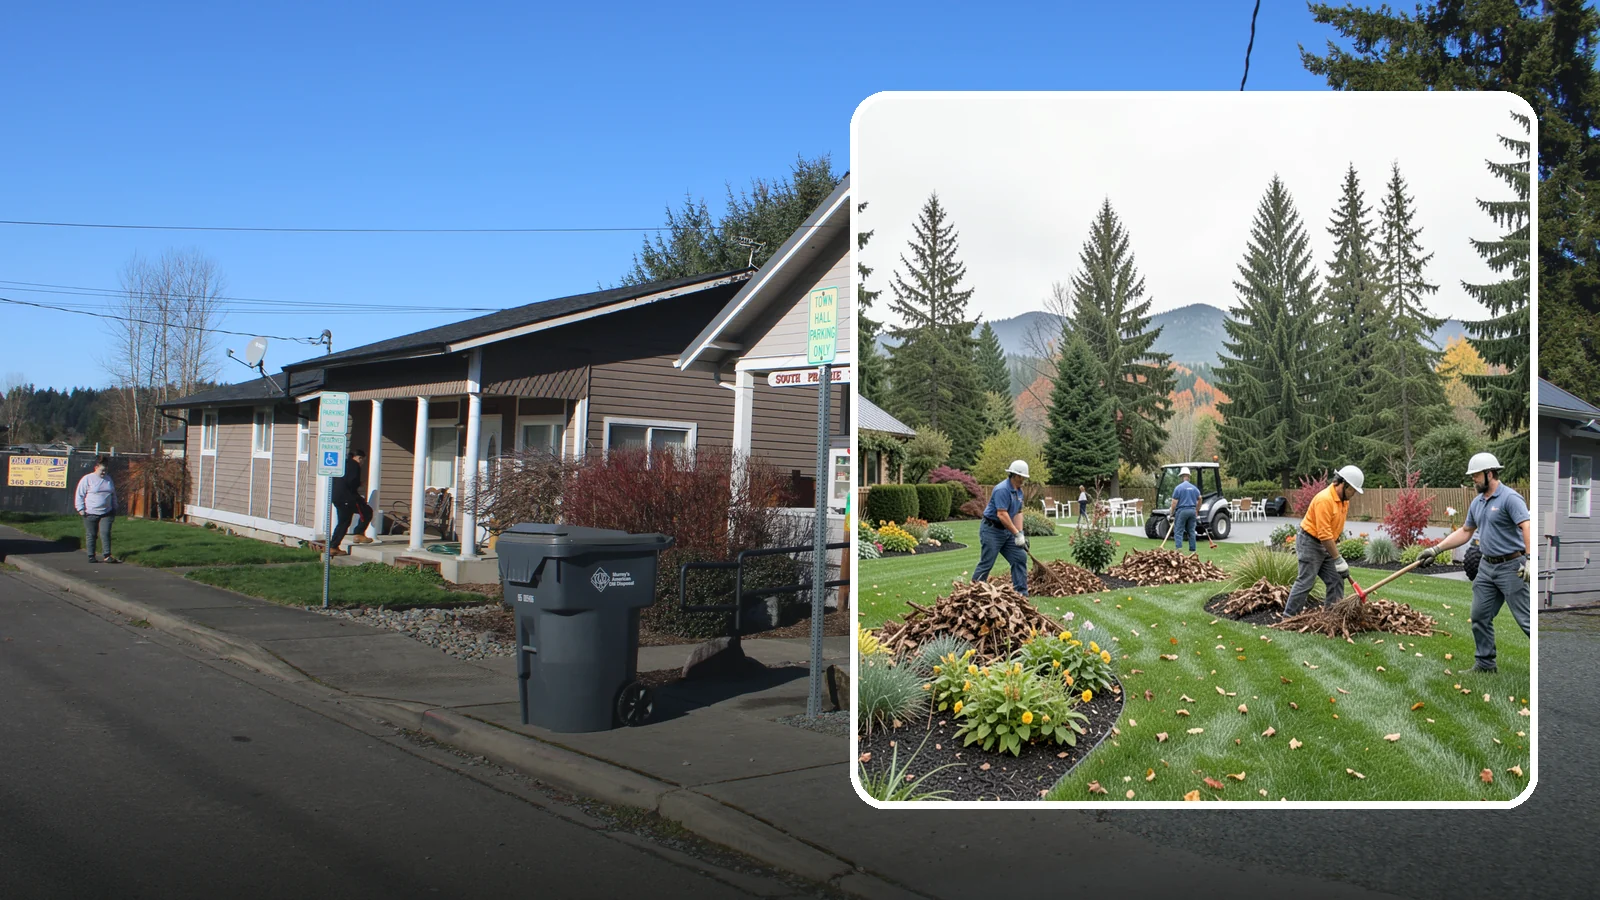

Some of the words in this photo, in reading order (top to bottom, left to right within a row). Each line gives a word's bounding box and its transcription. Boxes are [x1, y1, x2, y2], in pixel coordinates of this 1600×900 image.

[815, 294, 833, 308] TOWN
[814, 311, 831, 324] HALL
[810, 326, 836, 340] PARKING
[814, 344, 830, 356] ONLY
[775, 373, 801, 384] SOUTH
